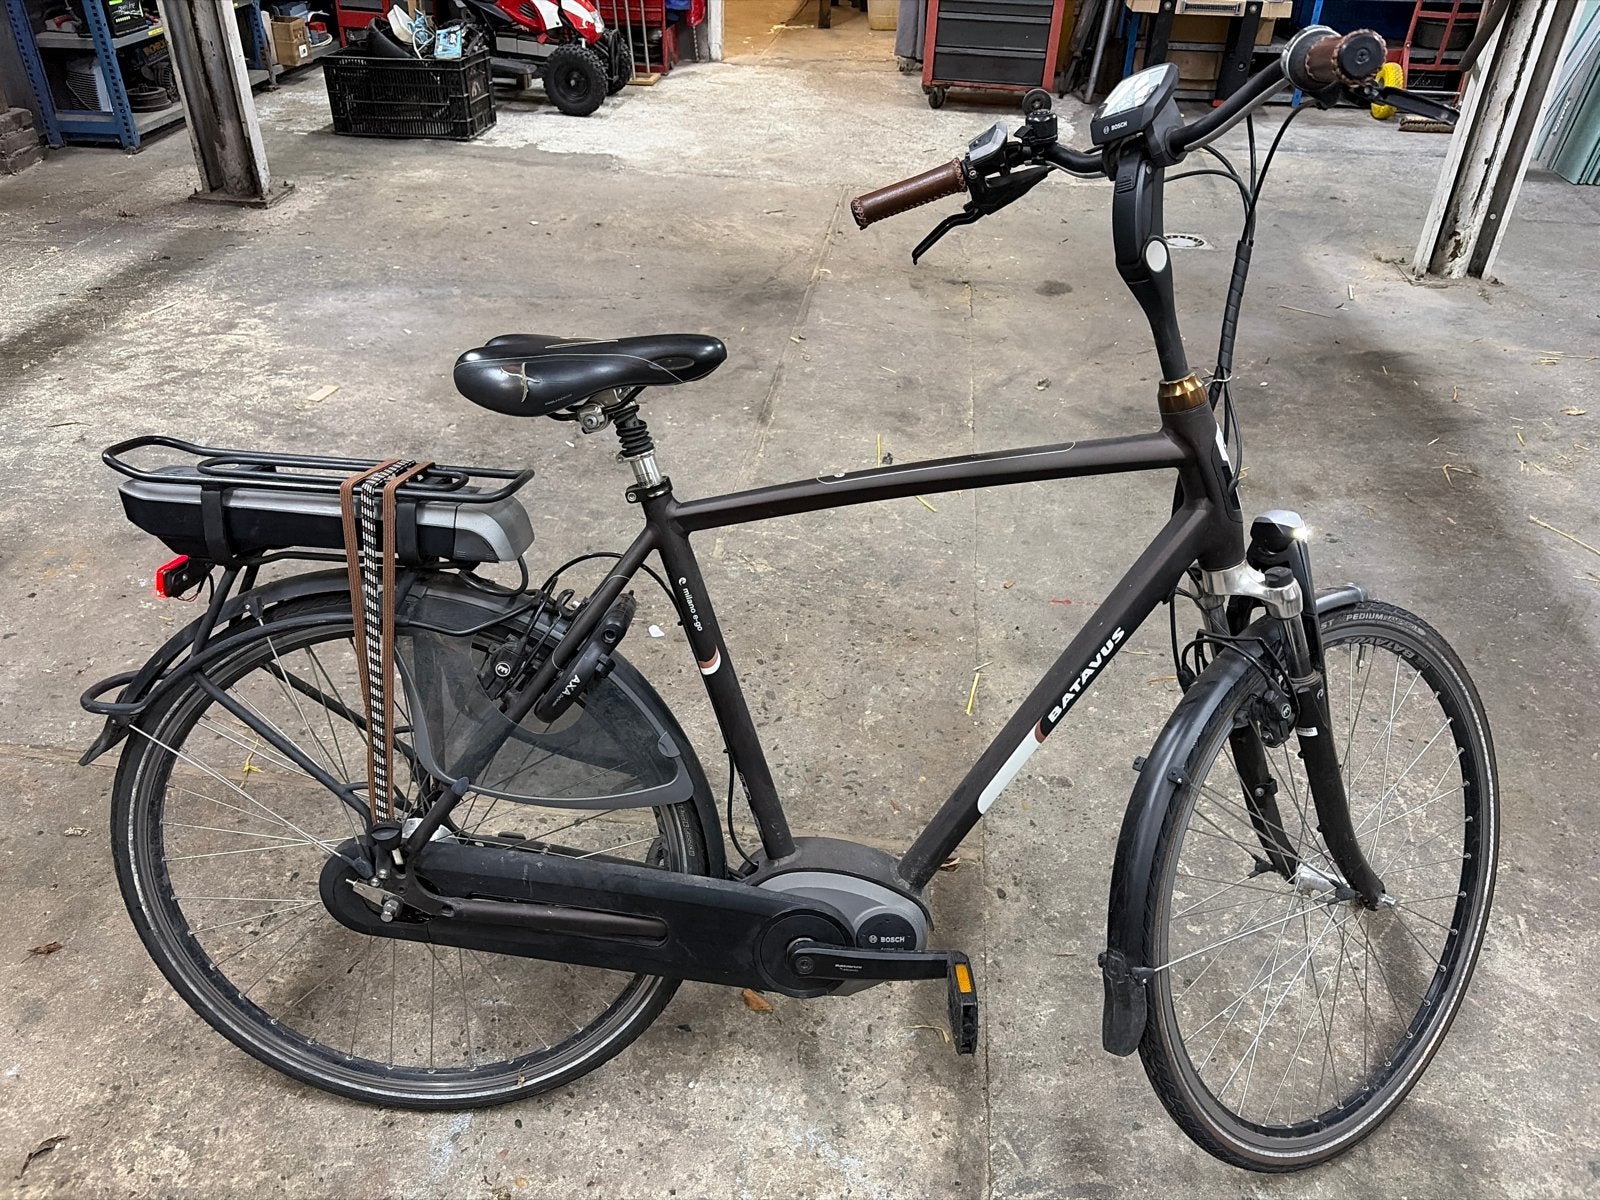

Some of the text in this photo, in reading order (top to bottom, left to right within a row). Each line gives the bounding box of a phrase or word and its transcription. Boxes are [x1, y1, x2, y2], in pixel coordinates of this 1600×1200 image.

[1111, 121, 1127, 130] BOSCH
[683, 588, 696, 613] milano
[693, 615, 703, 631] e-go
[562, 674, 580, 695] AXA
[1047, 627, 1125, 723] BATAVUS
